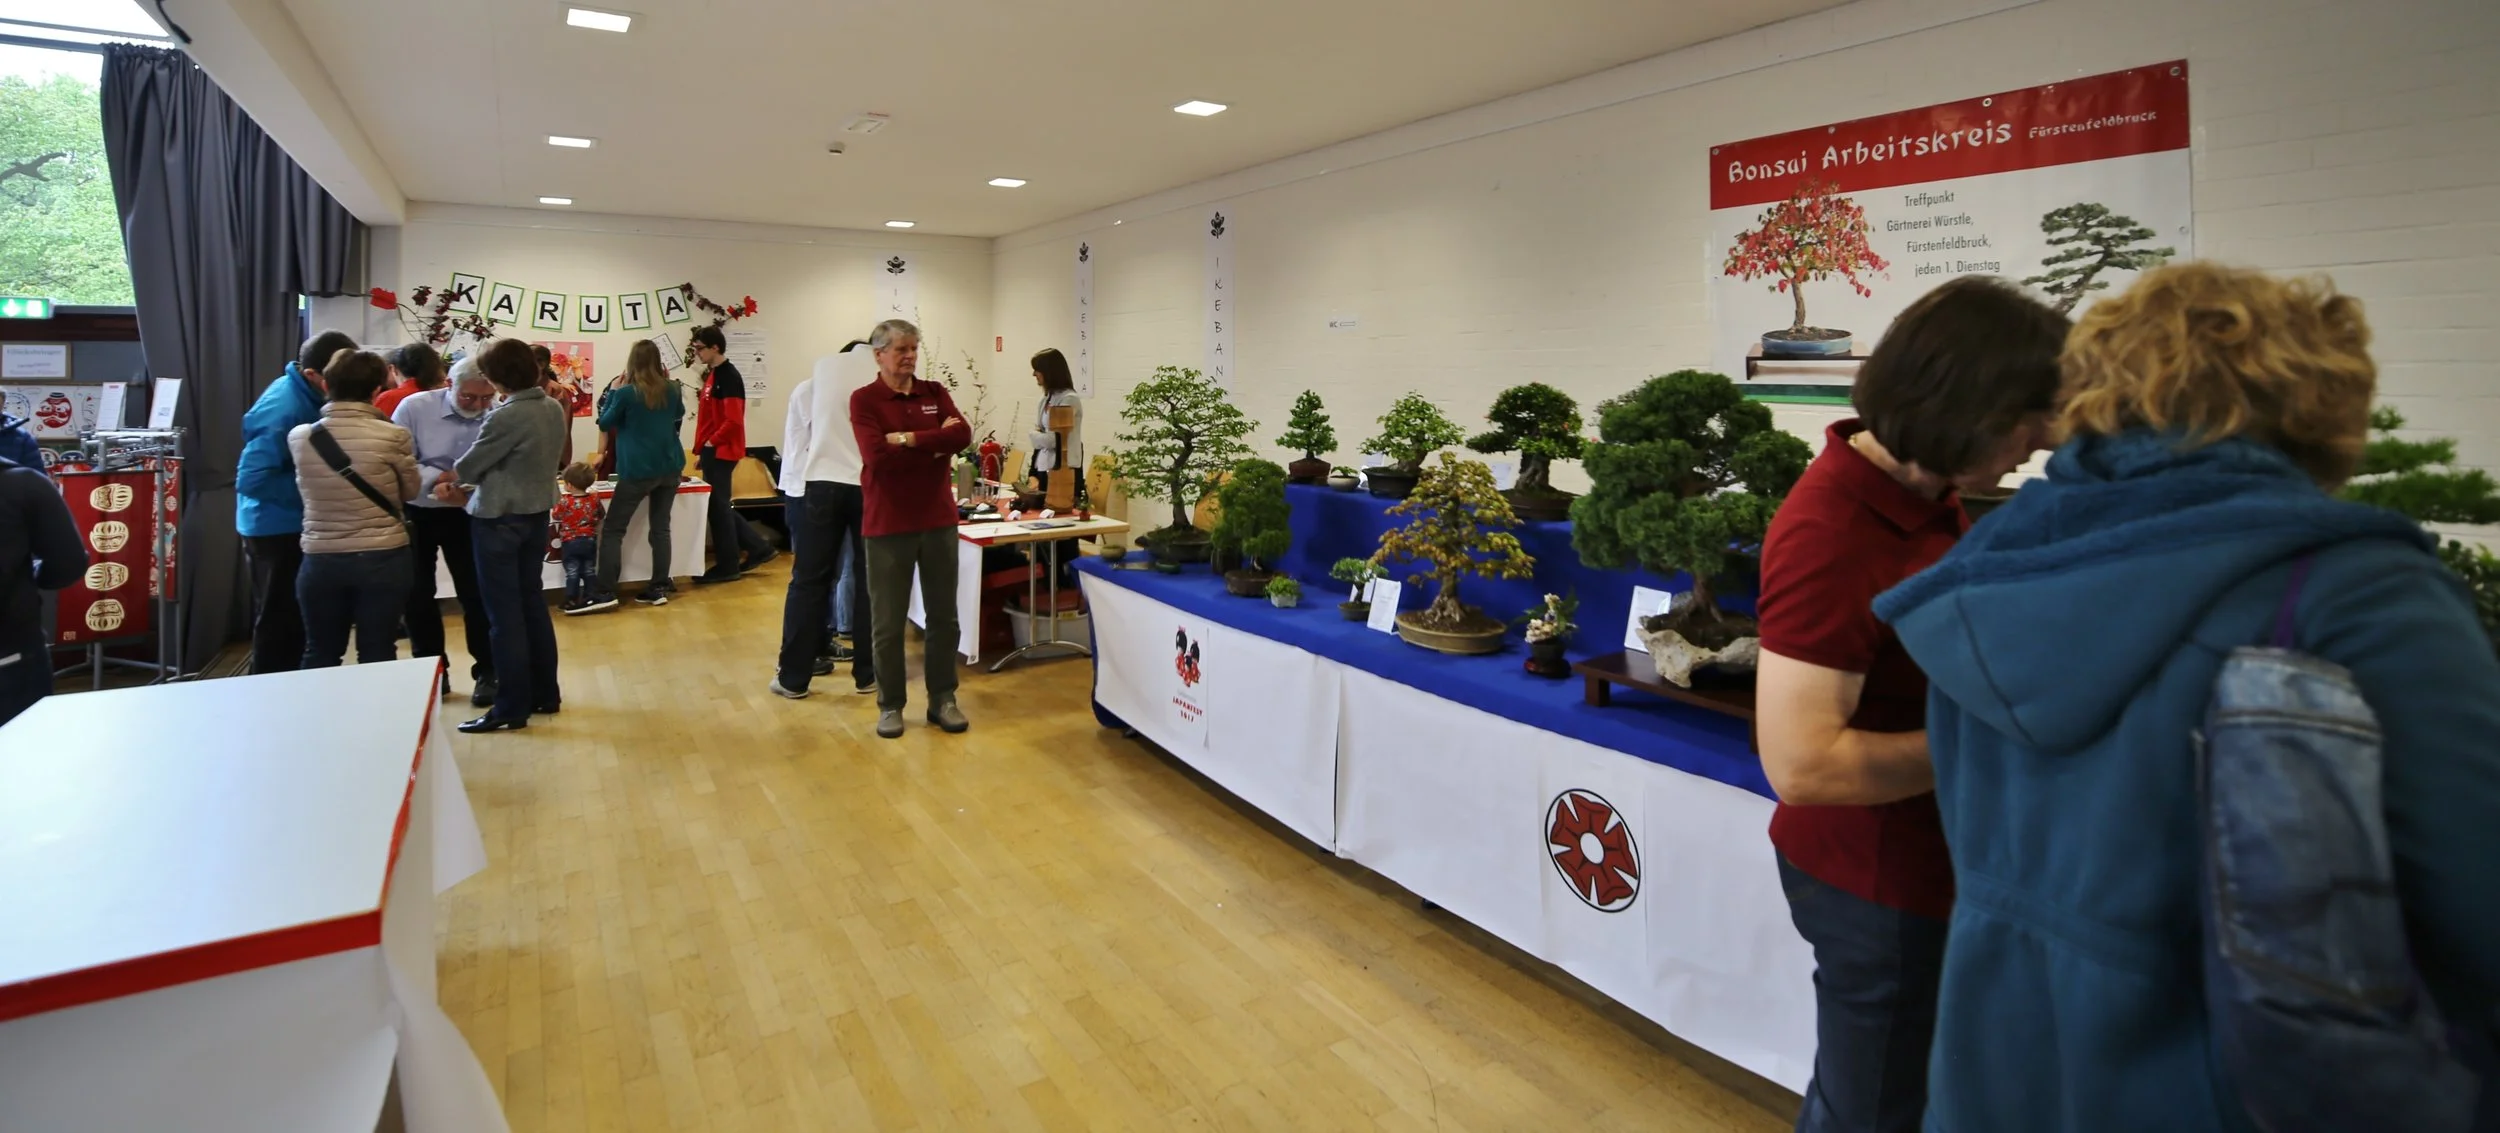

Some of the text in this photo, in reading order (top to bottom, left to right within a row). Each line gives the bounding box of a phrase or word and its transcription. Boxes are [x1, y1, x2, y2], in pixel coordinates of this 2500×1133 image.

[1729, 109, 2158, 184] Bonsai Arbeitskreis Fürstenfeldbruck
[1904, 190, 1955, 208] Treffpunkt
[1886, 213, 1974, 232] Gärtnerei Würstle,
[1907, 235, 1992, 254] Fürstenfeldbruck,
[1914, 258, 2001, 278] jeden 1. Dienstag
[456, 281, 685, 325] KARUTA
[1214, 256, 1224, 377] IKEBAN
[1080, 278, 1088, 393] IKEBANA
